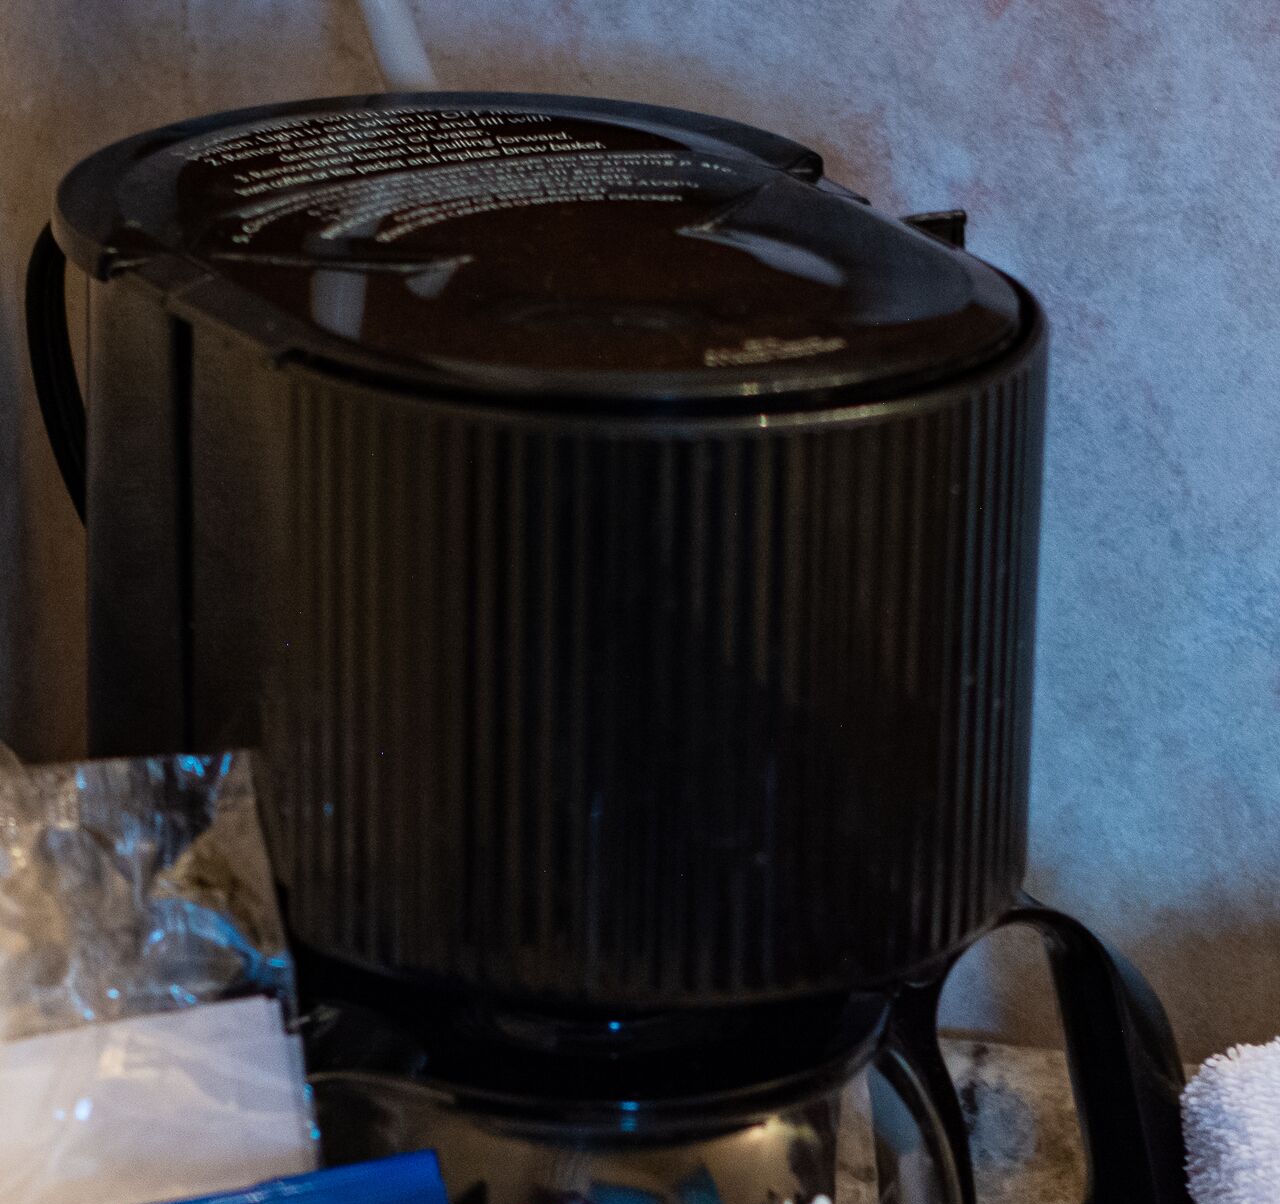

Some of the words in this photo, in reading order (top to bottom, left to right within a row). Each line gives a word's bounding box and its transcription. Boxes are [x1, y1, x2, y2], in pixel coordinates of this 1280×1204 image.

[294, 133, 348, 149] carafe
[346, 128, 397, 140] from
[397, 122, 437, 133] unit
[438, 119, 477, 130] and
[478, 116, 504, 126] fill
[507, 114, 552, 124] with
[323, 121, 357, 133] out
[357, 116, 416, 128] when
[416, 113, 439, 121] in
[279, 145, 339, 162] desired
[338, 136, 408, 152] amount
[407, 132, 428, 143] of
[428, 129, 492, 141] water.
[309, 154, 353, 169] brew
[352, 147, 408, 161] basket
[405, 143, 431, 155] by
[432, 137, 496, 152] pulling
[495, 130, 573, 145] forward.
[311, 171, 329, 181] or
[328, 166, 357, 178] tea
[354, 159, 408, 176] packet
[406, 153, 441, 166] and
[439, 148, 501, 163] replace
[500, 143, 547, 156] brew
[548, 140, 607, 152] basket.
